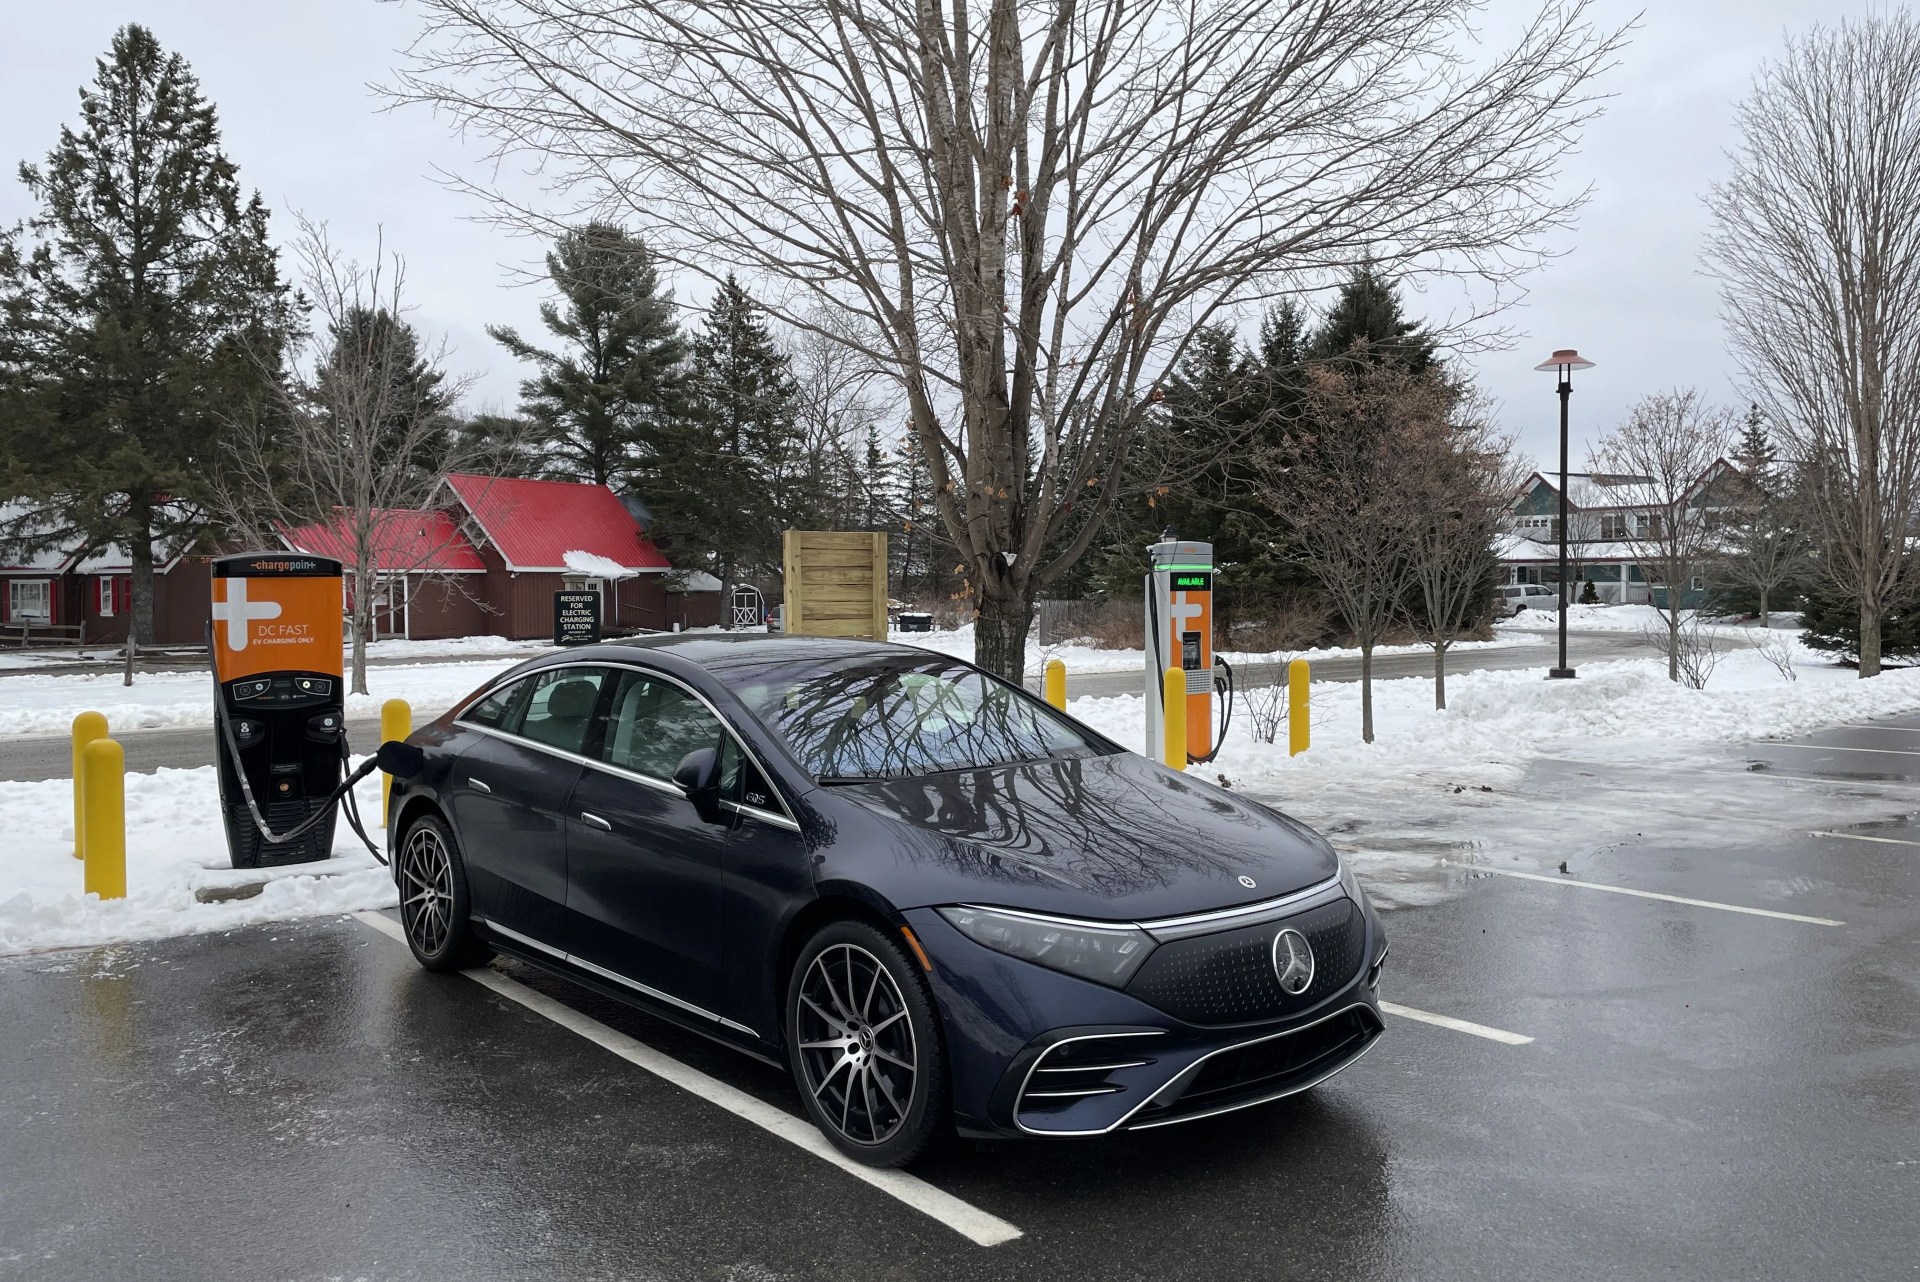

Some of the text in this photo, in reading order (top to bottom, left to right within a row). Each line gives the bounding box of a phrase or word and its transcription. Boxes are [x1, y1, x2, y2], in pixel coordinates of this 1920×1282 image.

[1177, 578, 1204, 586] AVAILABLE
[258, 624, 309, 636] DC FAST
[746, 792, 766, 805] EQS
